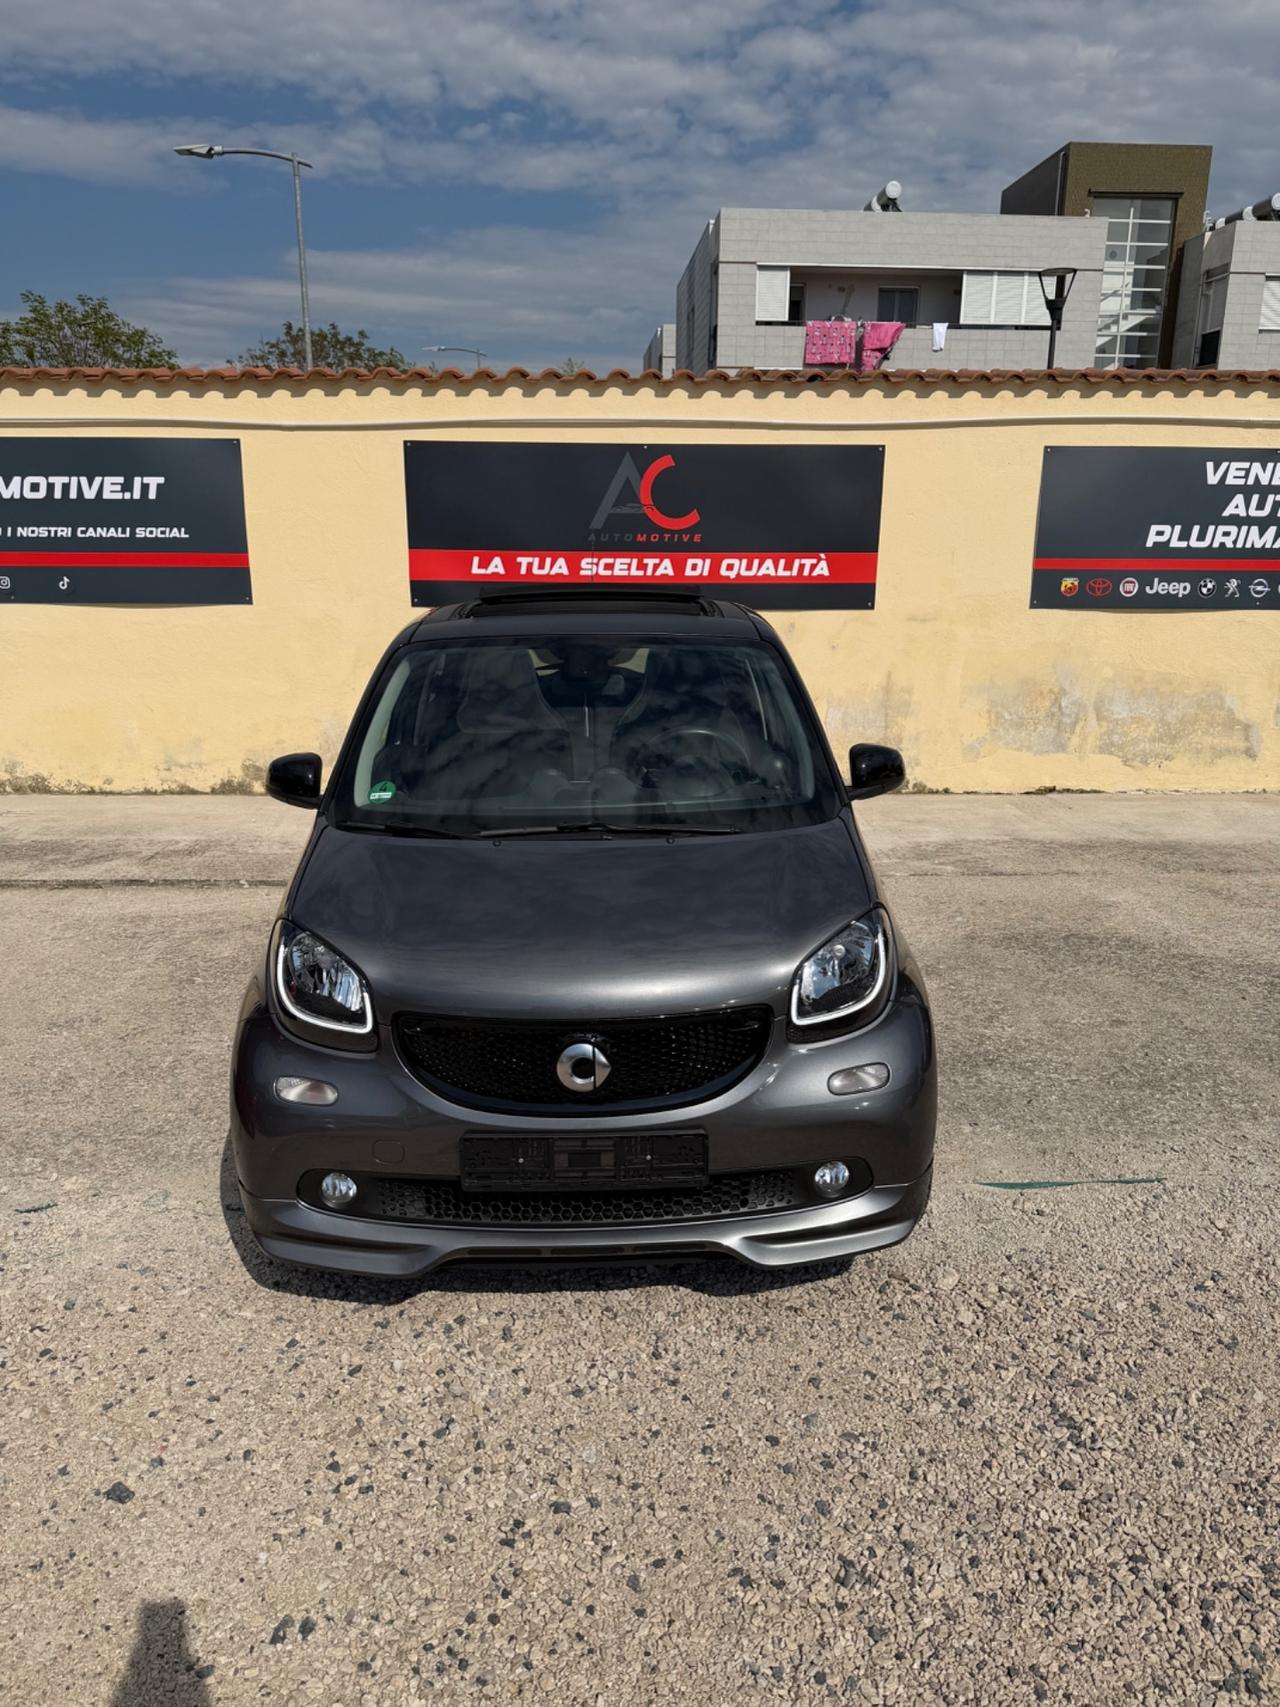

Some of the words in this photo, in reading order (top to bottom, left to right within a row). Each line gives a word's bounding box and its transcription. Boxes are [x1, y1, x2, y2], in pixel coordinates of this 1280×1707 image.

[0, 476, 165, 500] MOTIVE.IT
[7, 527, 12, 537] I
[17, 527, 72, 538] NOSTRI
[77, 527, 130, 538] CANALI
[135, 527, 189, 538] SOCIAL
[588, 533, 702, 542] AUTOMOTIVE
[1145, 524, 1280, 549] PLURIM
[470, 556, 506, 575] LA
[516, 556, 569, 576] TUA
[579, 557, 675, 577] SCELTA
[684, 558, 711, 577] DI
[720, 554, 831, 580] QUALITÀ
[1145, 578, 1191, 597] Jeep
